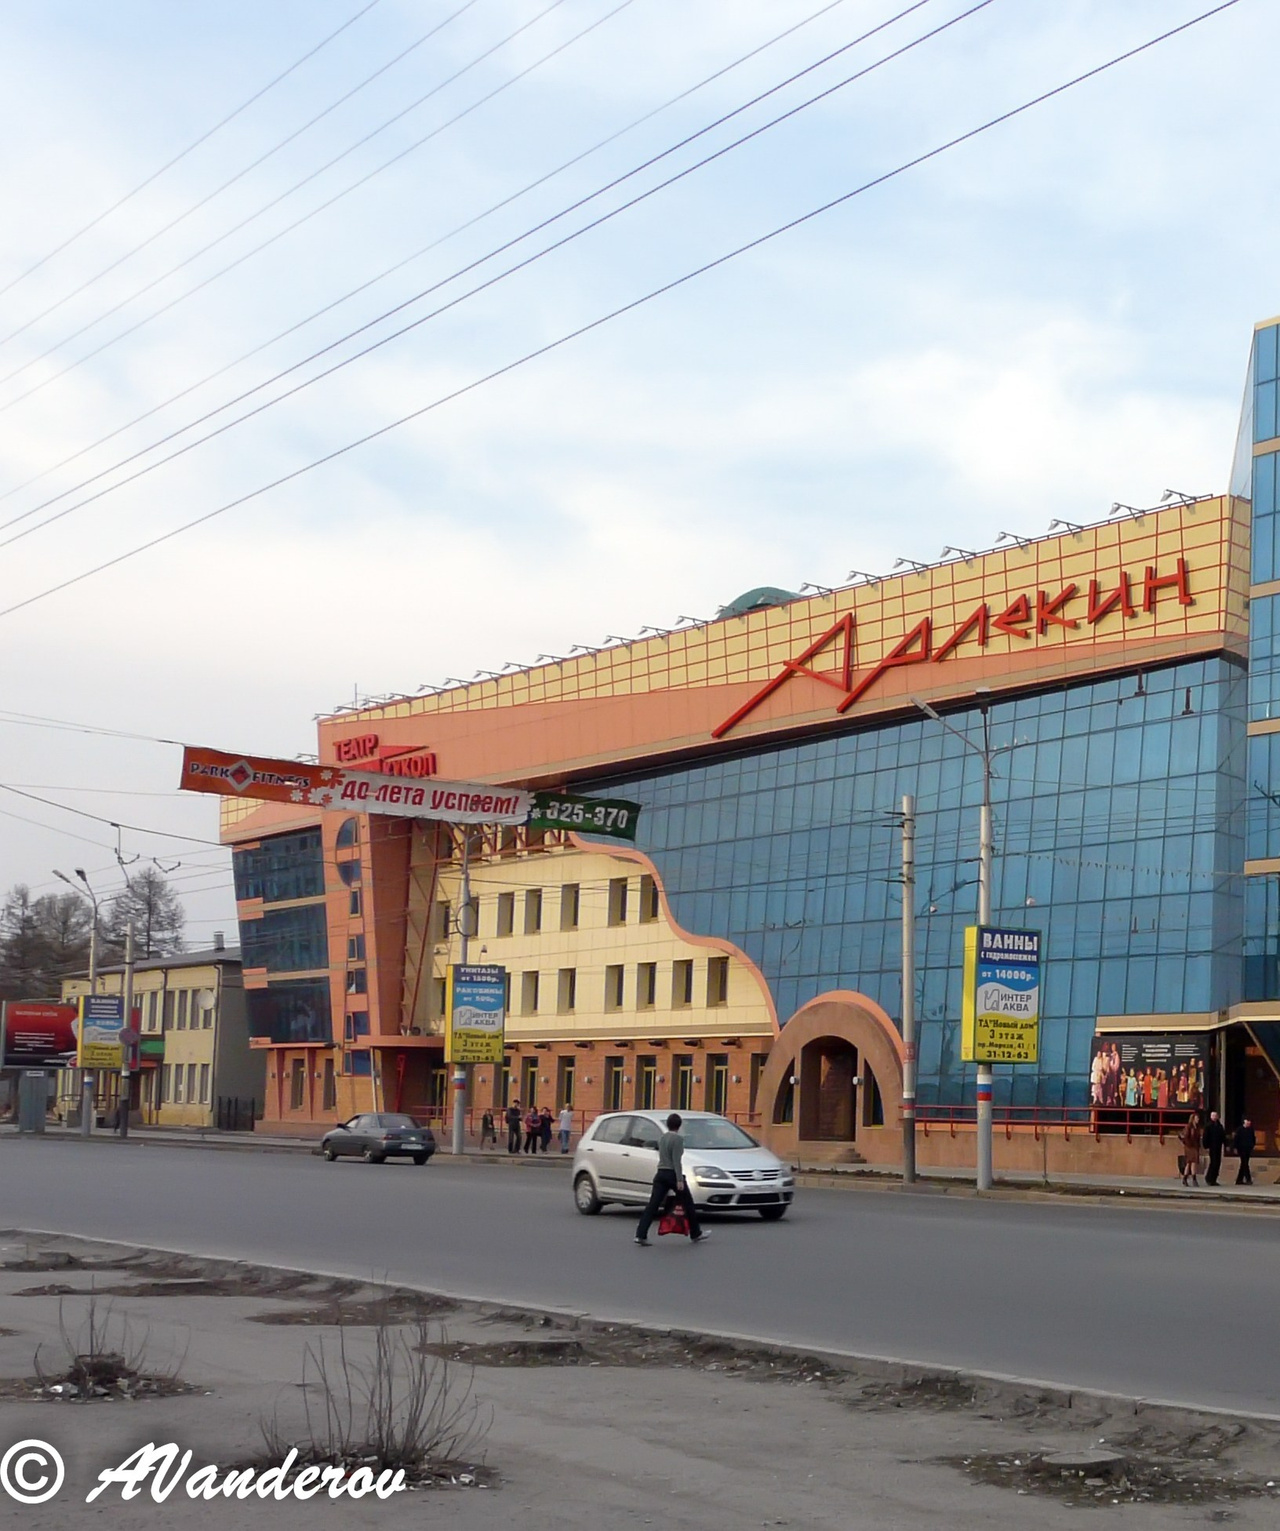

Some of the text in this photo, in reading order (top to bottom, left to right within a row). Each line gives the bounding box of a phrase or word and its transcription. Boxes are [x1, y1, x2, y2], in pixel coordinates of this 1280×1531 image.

[333, 734, 379, 762] ТЕАТР
[190, 762, 230, 778] PARK
[381, 753, 436, 777] КУКОЛ
[375, 784, 425, 806] лета
[430, 790, 520, 815] успеем!
[547, 801, 629, 829] 325-370
[983, 933, 1038, 951] ВАННЫ
[461, 967, 499, 975] УНИТАЗЫ
[1001, 993, 1032, 1003] ИНТЕР
[1003, 1003, 1030, 1012] АКВА
[990, 1030, 995, 1039] 3
[986, 1051, 1029, 1059] 31-12-63
